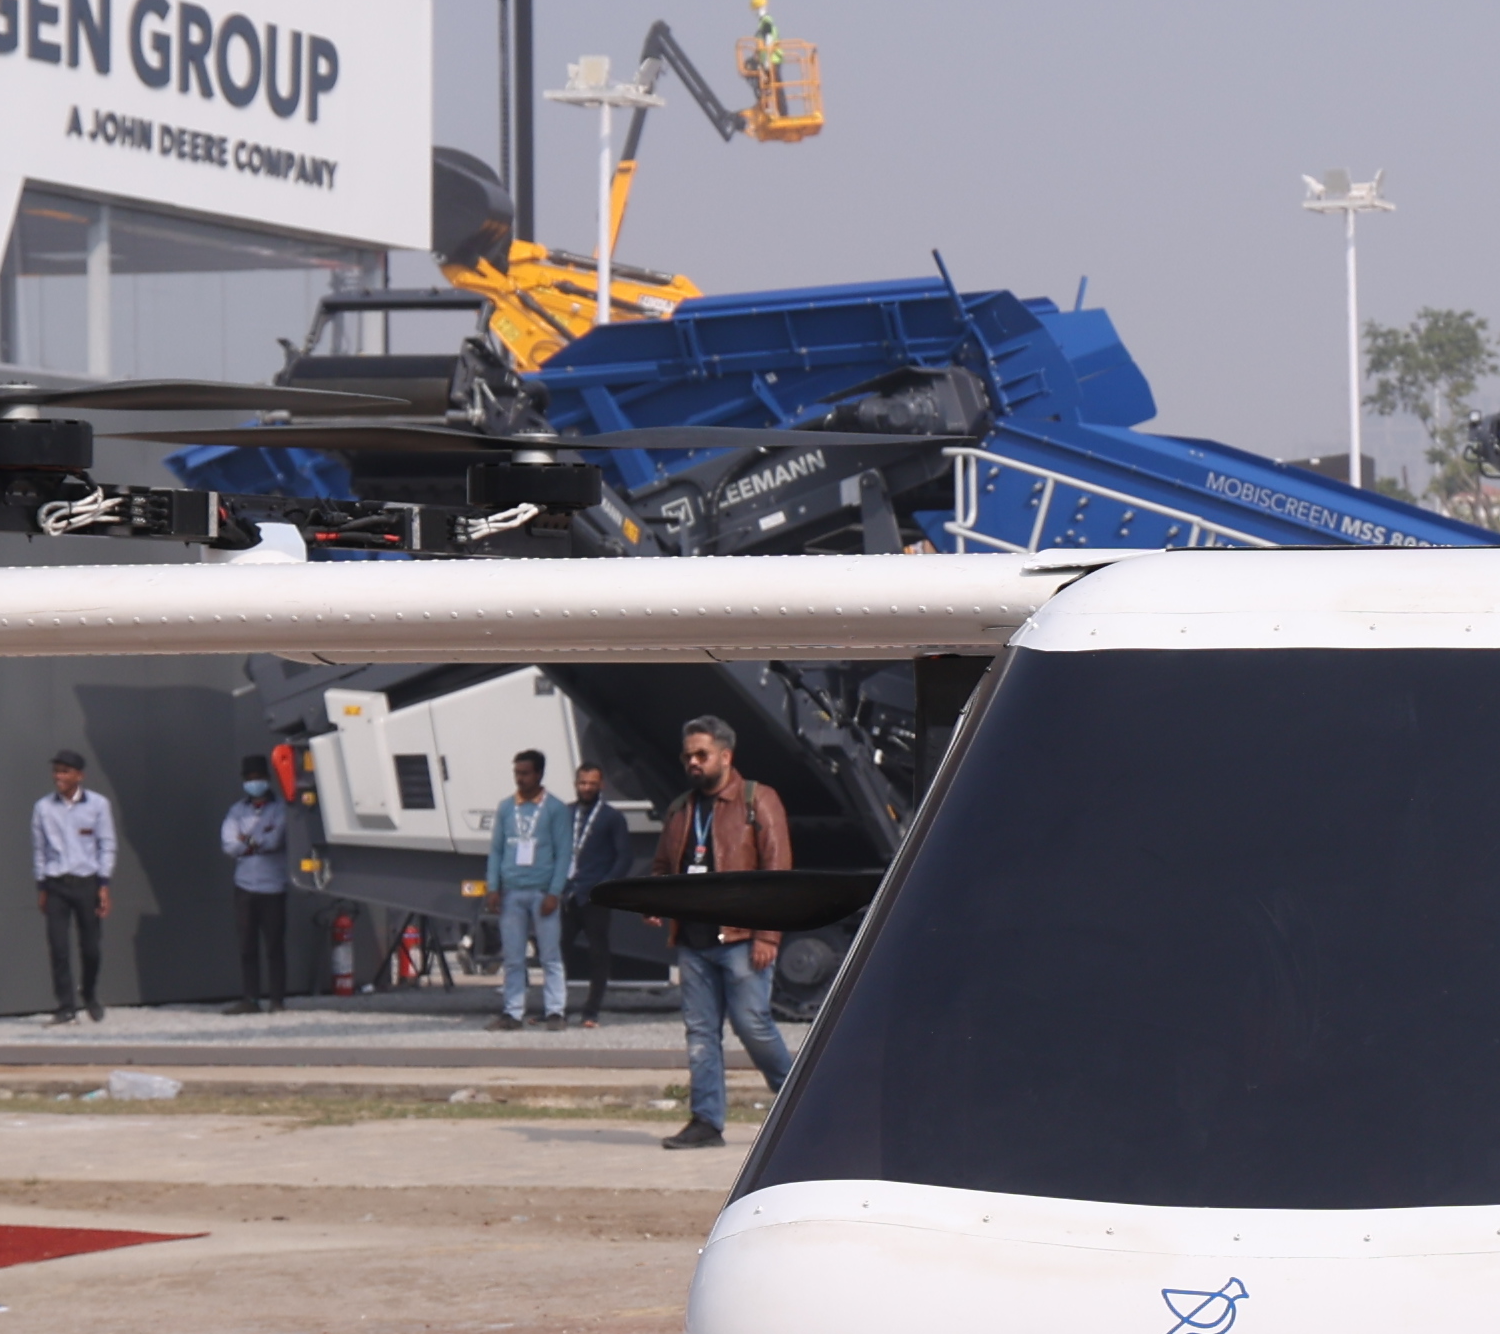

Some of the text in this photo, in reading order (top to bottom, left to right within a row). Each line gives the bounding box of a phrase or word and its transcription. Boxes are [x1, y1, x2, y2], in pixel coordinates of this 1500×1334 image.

[66, 105, 338, 190] A JOHN DEERE COMPANY
[1205, 471, 1339, 529] MOBISCREEN
[1340, 516, 1387, 545] MSS
